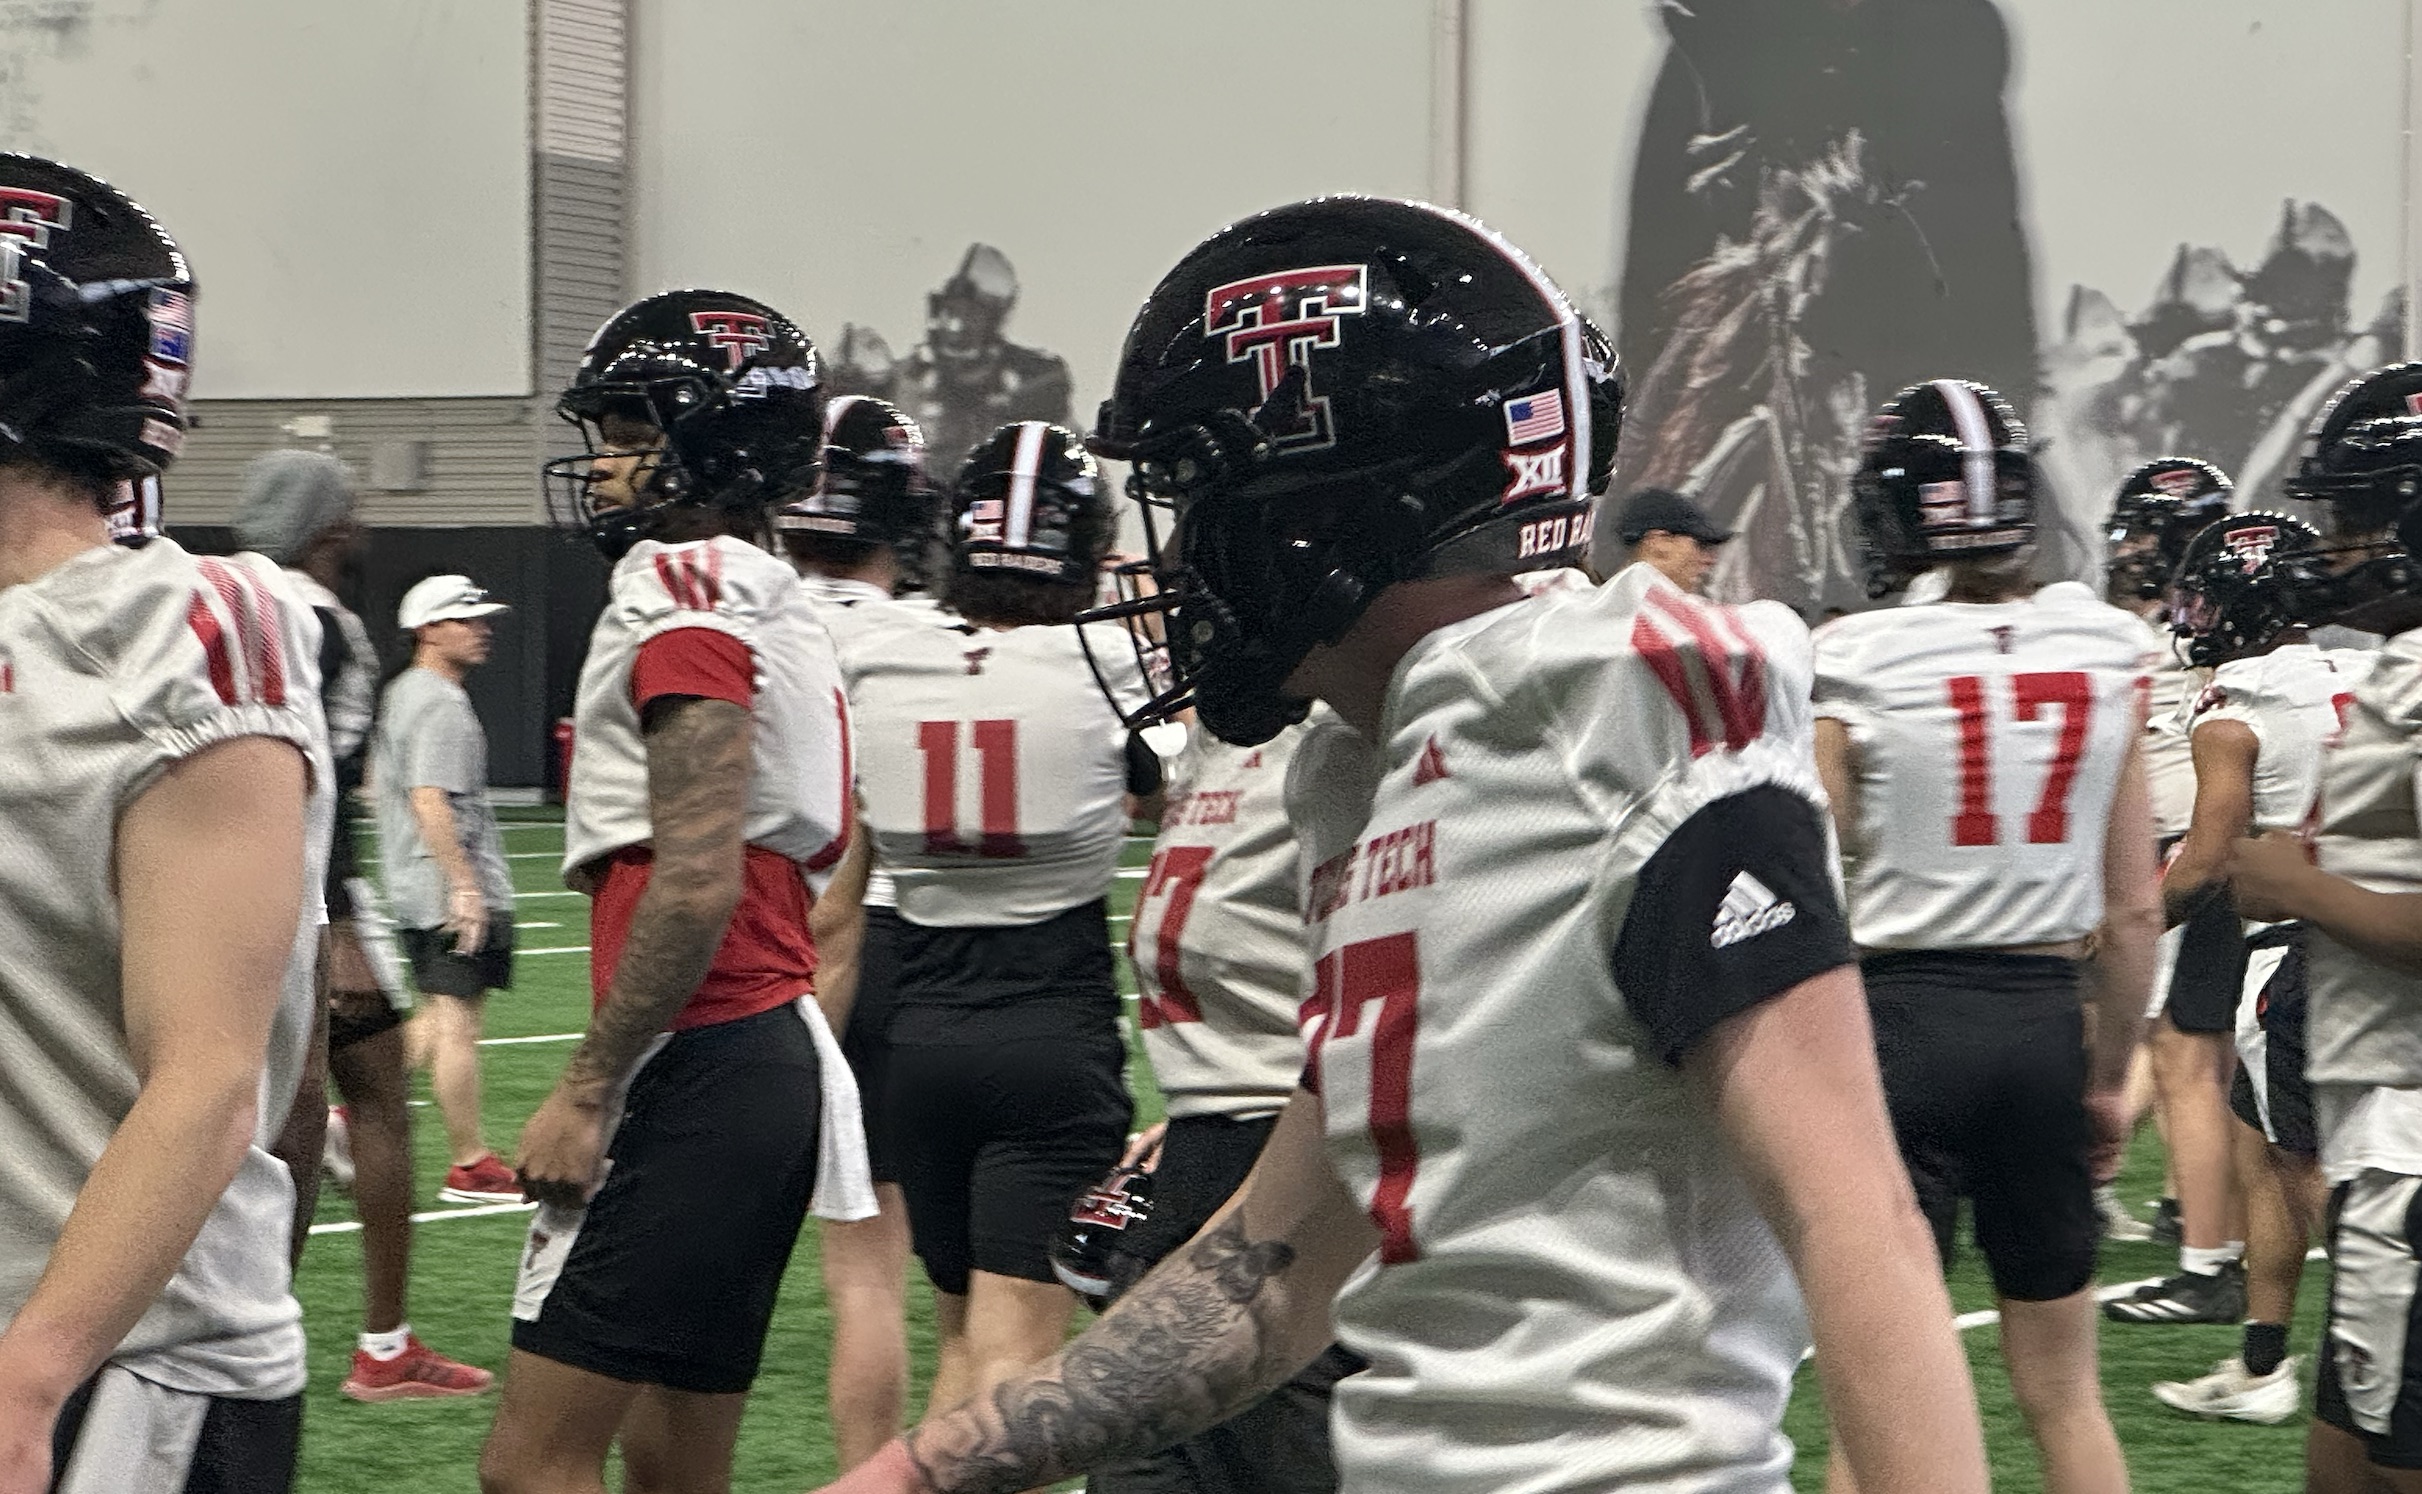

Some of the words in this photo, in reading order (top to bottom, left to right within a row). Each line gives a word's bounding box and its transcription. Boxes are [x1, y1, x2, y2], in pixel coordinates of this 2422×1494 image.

[1507, 442, 1567, 497] XII
[1518, 517, 1567, 559] RED
[915, 719, 1027, 858] 11
[1943, 672, 2093, 846] 17
[1360, 819, 1436, 902] TECH
